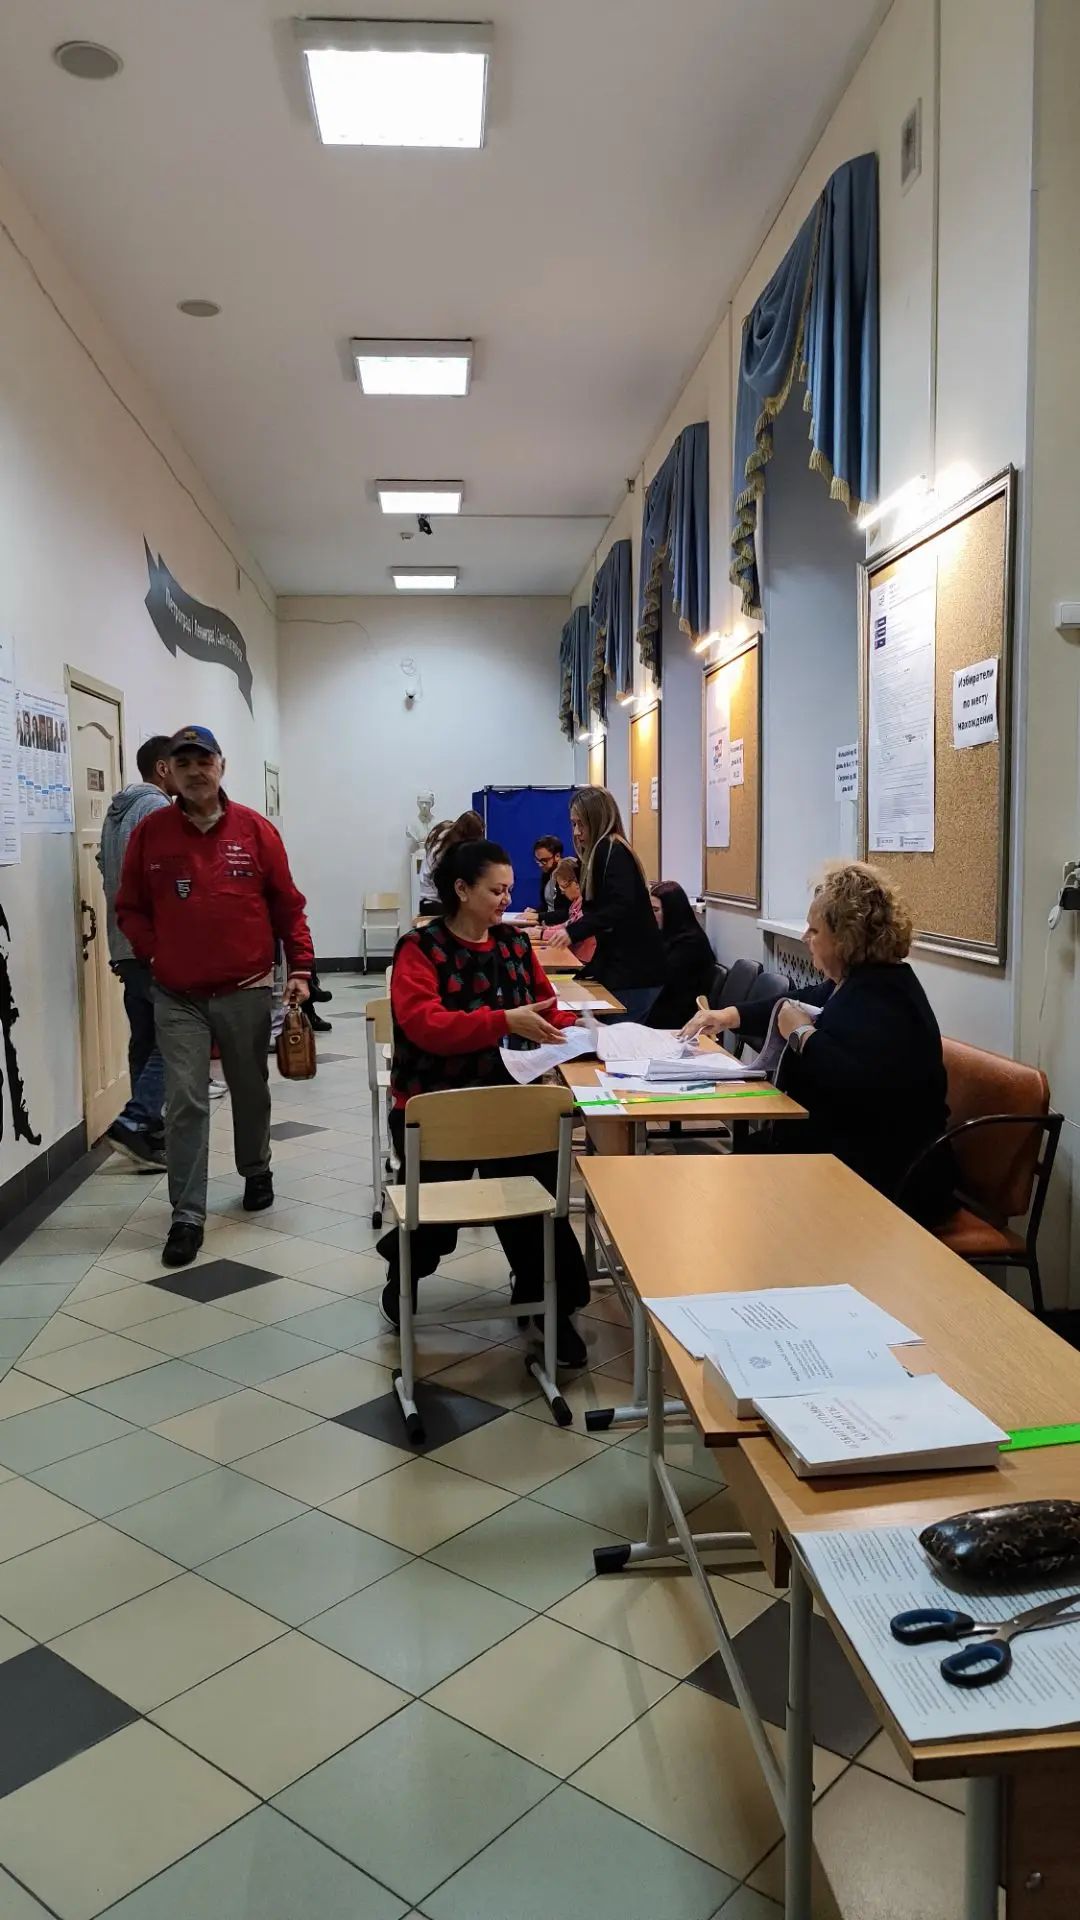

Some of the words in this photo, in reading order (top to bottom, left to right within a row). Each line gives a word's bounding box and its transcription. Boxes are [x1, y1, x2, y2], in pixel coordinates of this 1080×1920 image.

[958, 668, 994, 689] Избиратели
[962, 698, 971, 709] по
[971, 693, 989, 706] месту
[957, 713, 994, 731] нахождения
